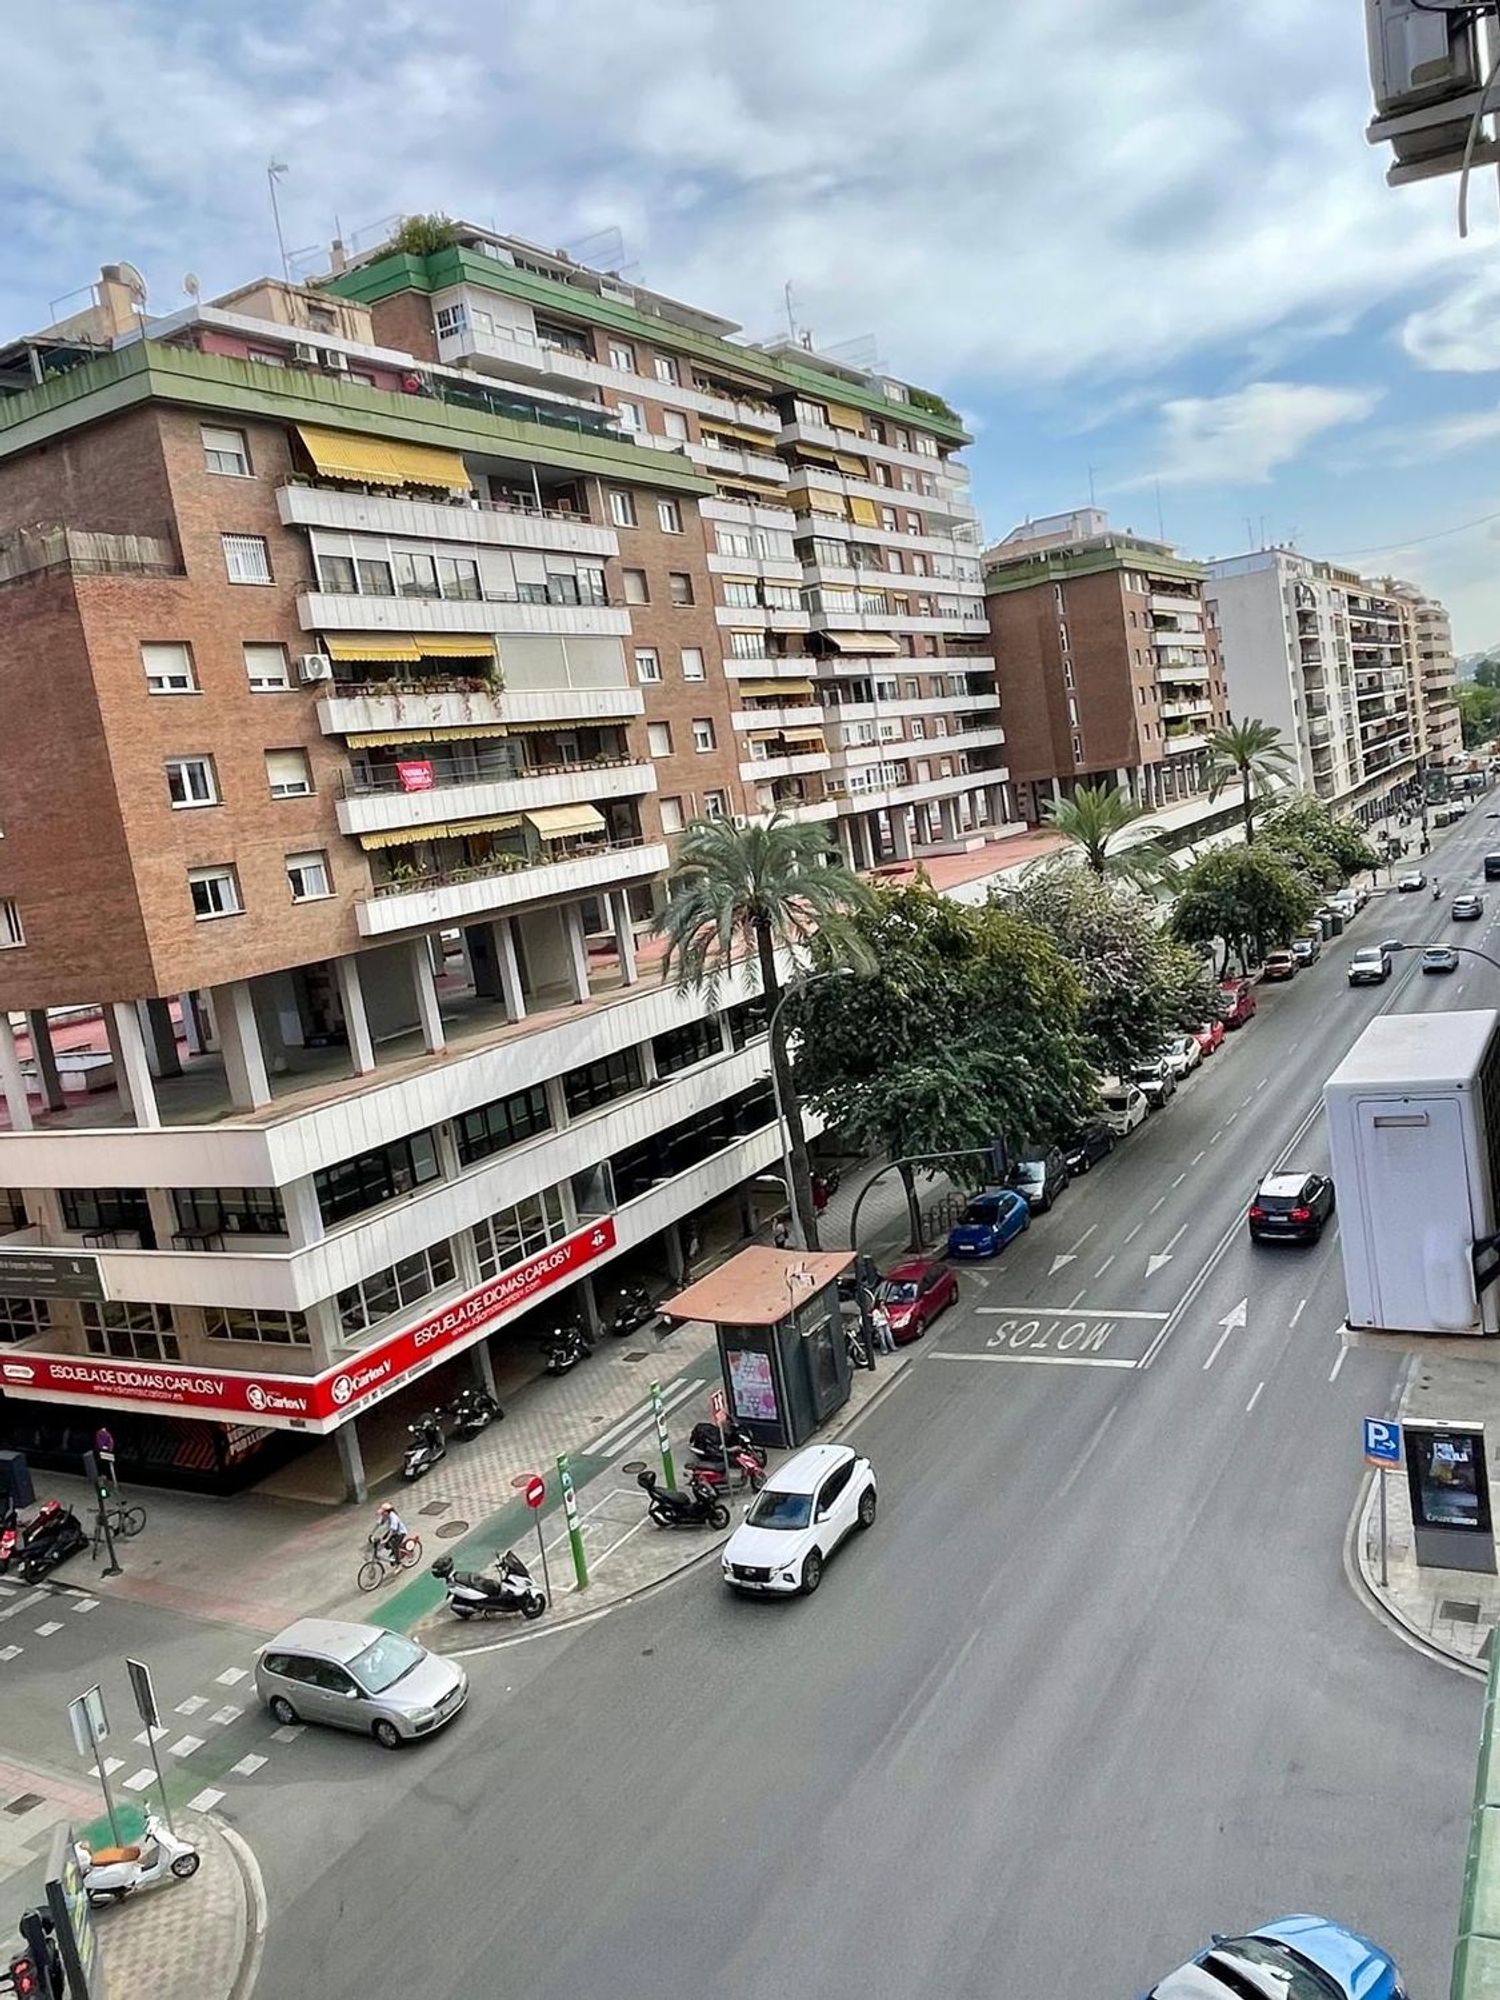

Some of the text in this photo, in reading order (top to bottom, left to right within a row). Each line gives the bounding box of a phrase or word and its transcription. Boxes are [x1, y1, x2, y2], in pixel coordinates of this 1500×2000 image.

[414, 1245, 572, 1347] ESCUELA DE IDIOMAS CARLOS V
[986, 1320, 1117, 1352] MOTOS
[49, 1364, 100, 1382] ESCUELA
[99, 1369, 117, 1384] DE
[115, 1372, 164, 1389] IDIOMAS
[164, 1376, 214, 1394] CARLOS
[213, 1382, 224, 1395] V
[353, 1366, 385, 1390] Carlos
[383, 1358, 391, 1372] V
[267, 1394, 307, 1411] Carlos V
[1367, 1422, 1390, 1449] P
